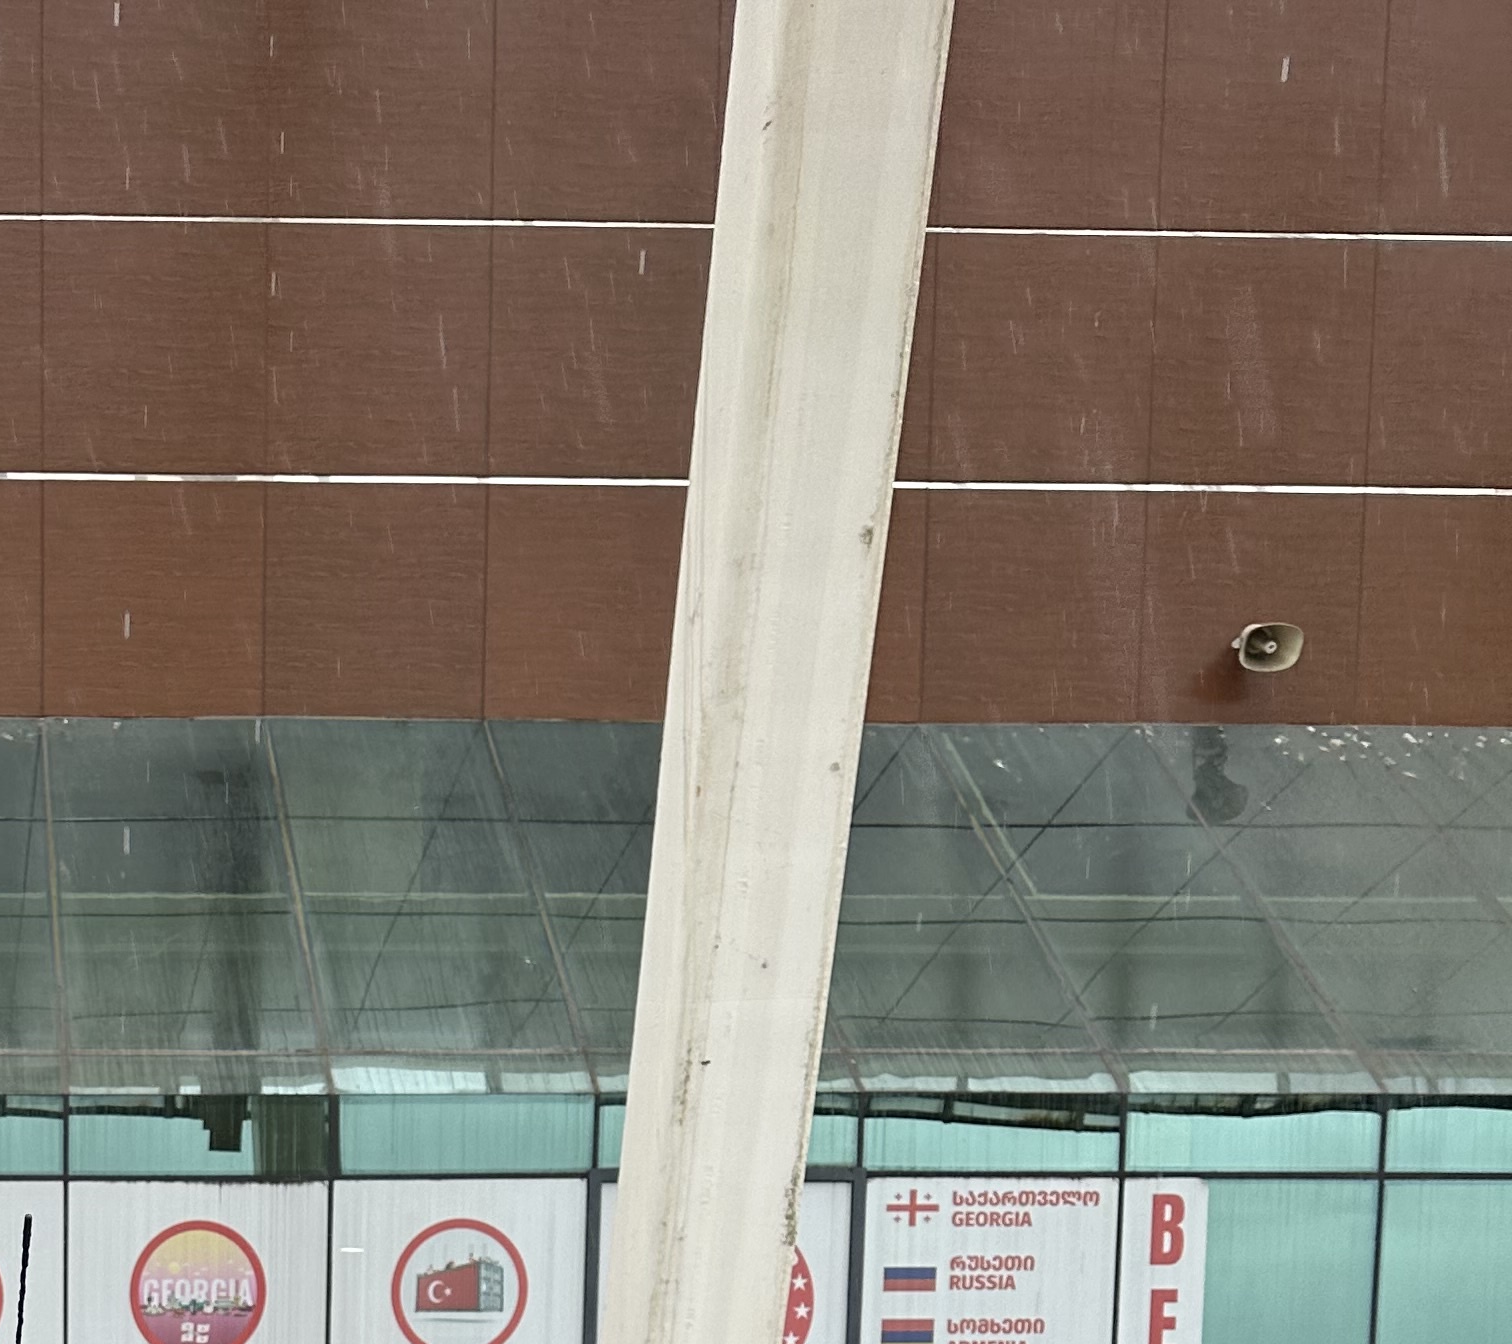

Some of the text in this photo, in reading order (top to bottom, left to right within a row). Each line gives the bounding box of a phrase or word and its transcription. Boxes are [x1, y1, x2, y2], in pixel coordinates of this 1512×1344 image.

[952, 1190, 1100, 1207] საქართველო
[951, 1211, 1032, 1227] GEORGIA
[950, 1255, 1035, 1271] რუსეთი
[949, 1275, 1016, 1290] RUSSIA
[947, 1318, 1045, 1334] სომხეთი
